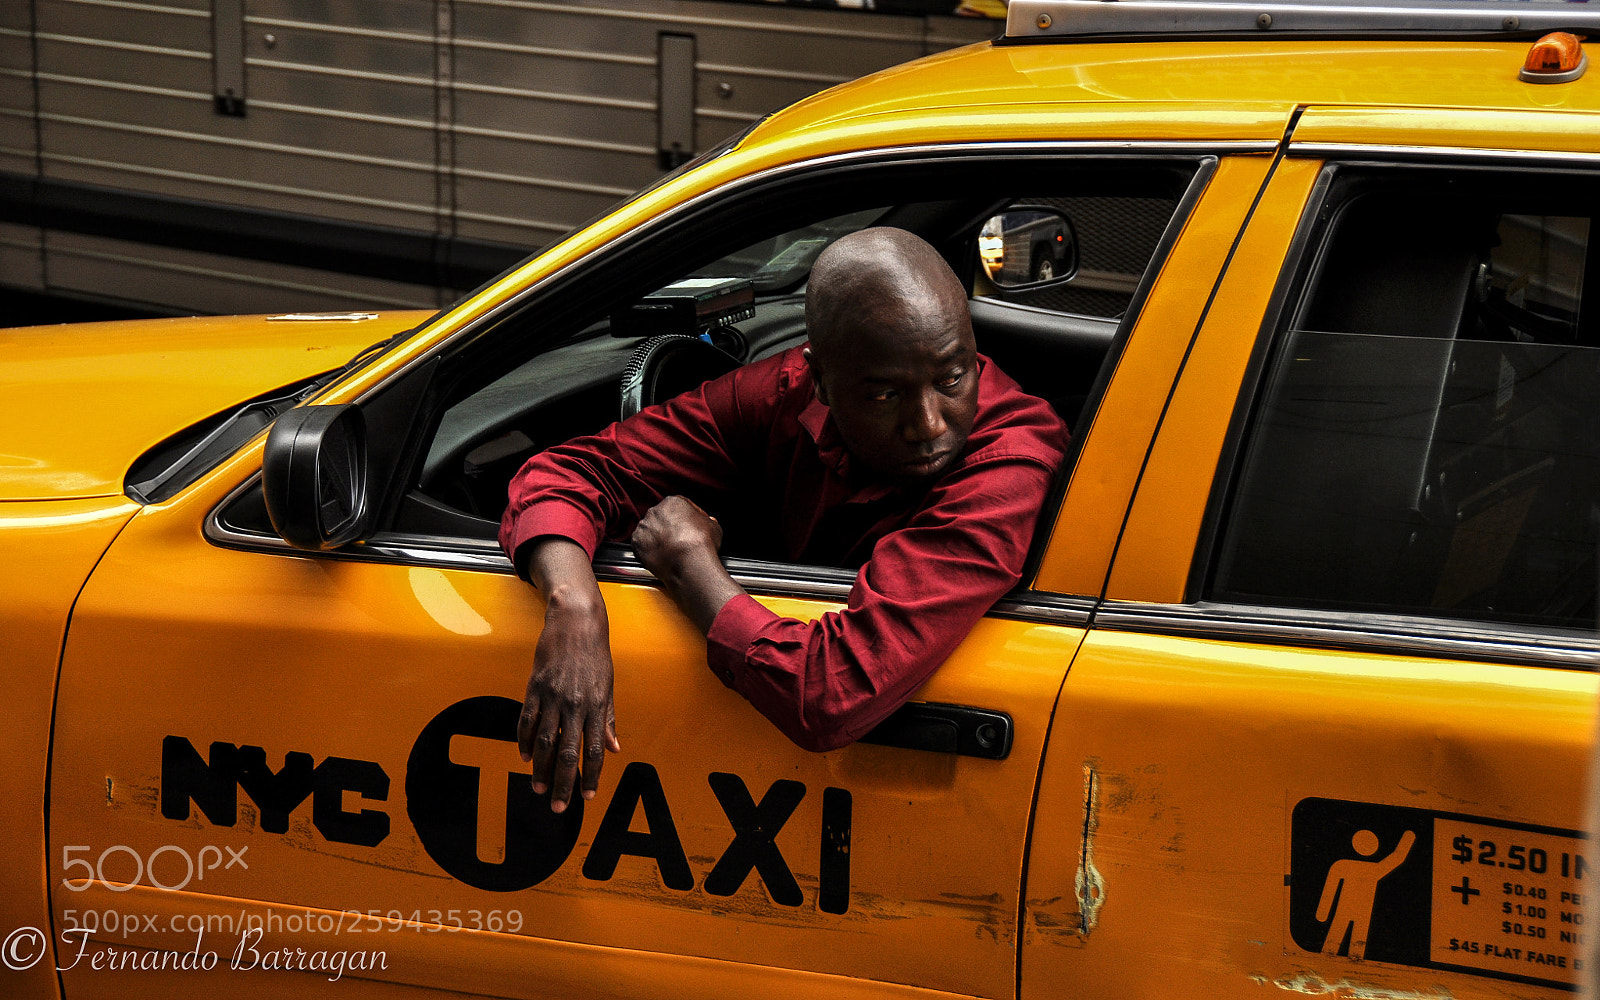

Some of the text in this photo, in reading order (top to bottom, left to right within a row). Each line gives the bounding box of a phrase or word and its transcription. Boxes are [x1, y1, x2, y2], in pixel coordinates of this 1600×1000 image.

[161, 732, 853, 915] NYC TAXI
[1452, 834, 1547, 874] $2.50
[1503, 882, 1547, 900] $0.40
[1502, 920, 1546, 939] $0.50
[1449, 937, 1479, 954] $45
[1484, 943, 1522, 960] FLAT
[1527, 950, 1567, 969] FARE
